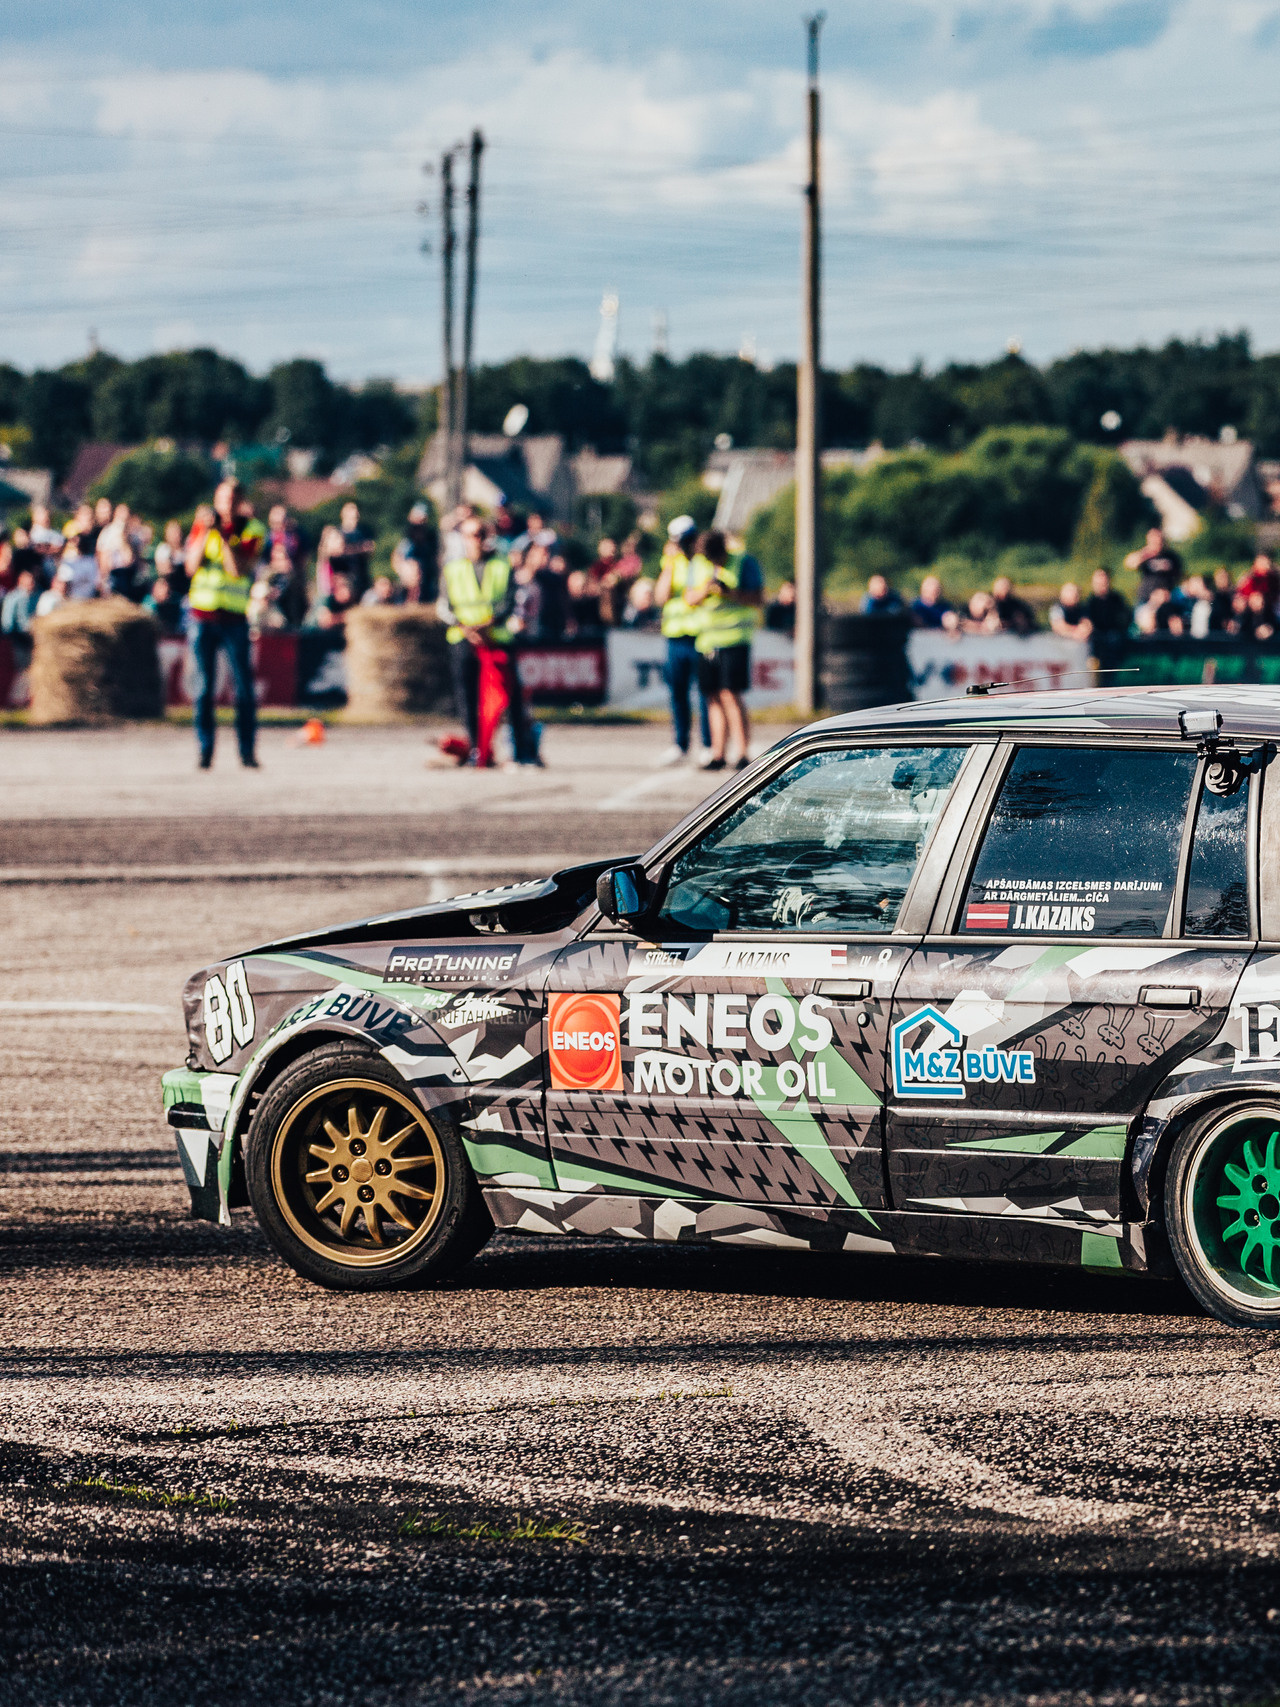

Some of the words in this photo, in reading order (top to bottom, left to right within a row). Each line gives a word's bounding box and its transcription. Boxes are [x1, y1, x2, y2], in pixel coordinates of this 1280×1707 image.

[986, 878, 1053, 890] APŠAUBĀMAS
[1055, 880, 1112, 891] IZCELSMES
[1113, 879, 1163, 892] DARĪJUMI
[983, 891, 998, 901] AR
[1012, 905, 1097, 932] J.KAZAKS
[643, 951, 682, 967] STREET
[721, 951, 733, 970] J.
[733, 952, 790, 971] KAZAKS
[875, 948, 893, 970] 8
[453, 992, 507, 1006] Auto
[203, 959, 256, 1065] 80
[629, 993, 834, 1051] ENEOS
[552, 1031, 615, 1052] ENEOS
[904, 1050, 960, 1080] M&Z
[967, 1047, 1035, 1081] BŪVE
[633, 1060, 767, 1097] MOTOR
[776, 1060, 836, 1097] OIL
